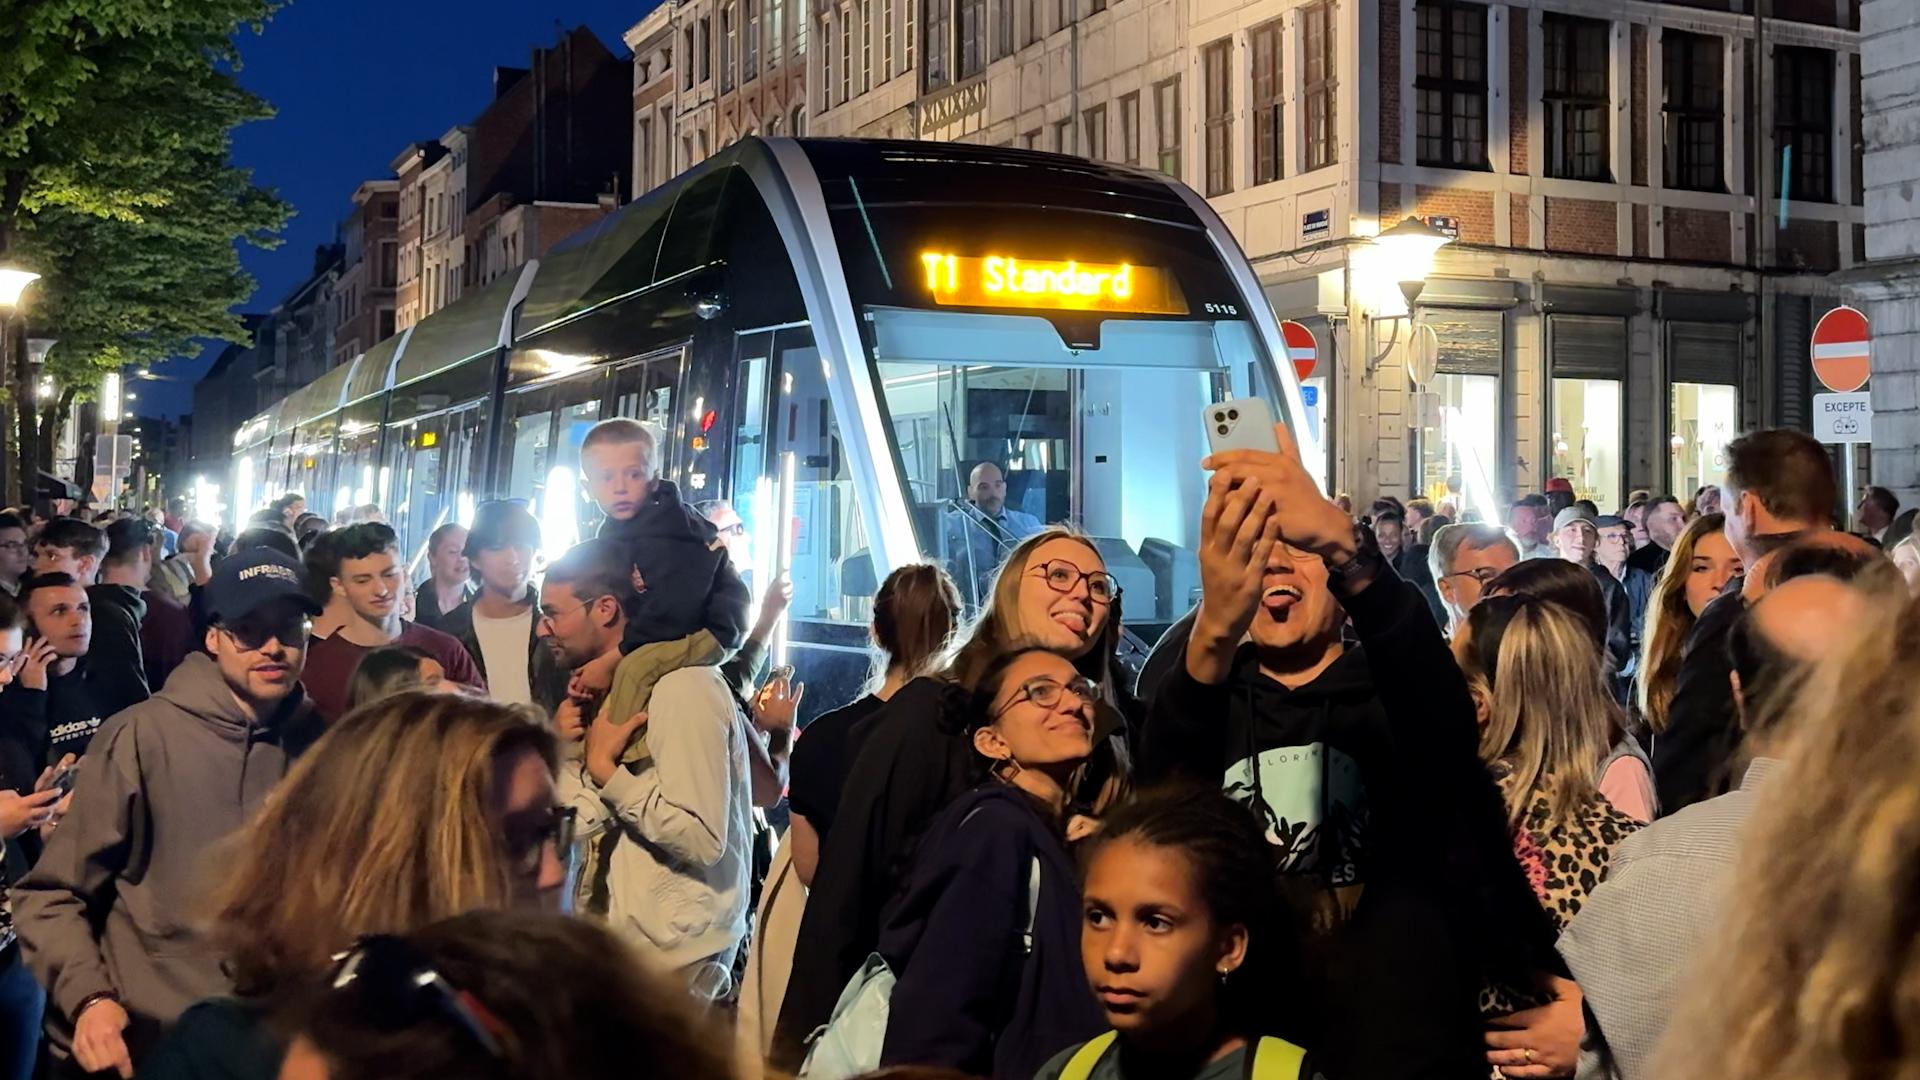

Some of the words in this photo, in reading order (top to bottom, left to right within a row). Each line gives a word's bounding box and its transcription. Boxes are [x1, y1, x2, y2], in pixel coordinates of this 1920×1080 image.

[922, 254, 956, 290] T1
[984, 256, 1131, 298] Standard
[1205, 303, 1238, 315] 5115
[1825, 402, 1867, 412] EXCEPTE
